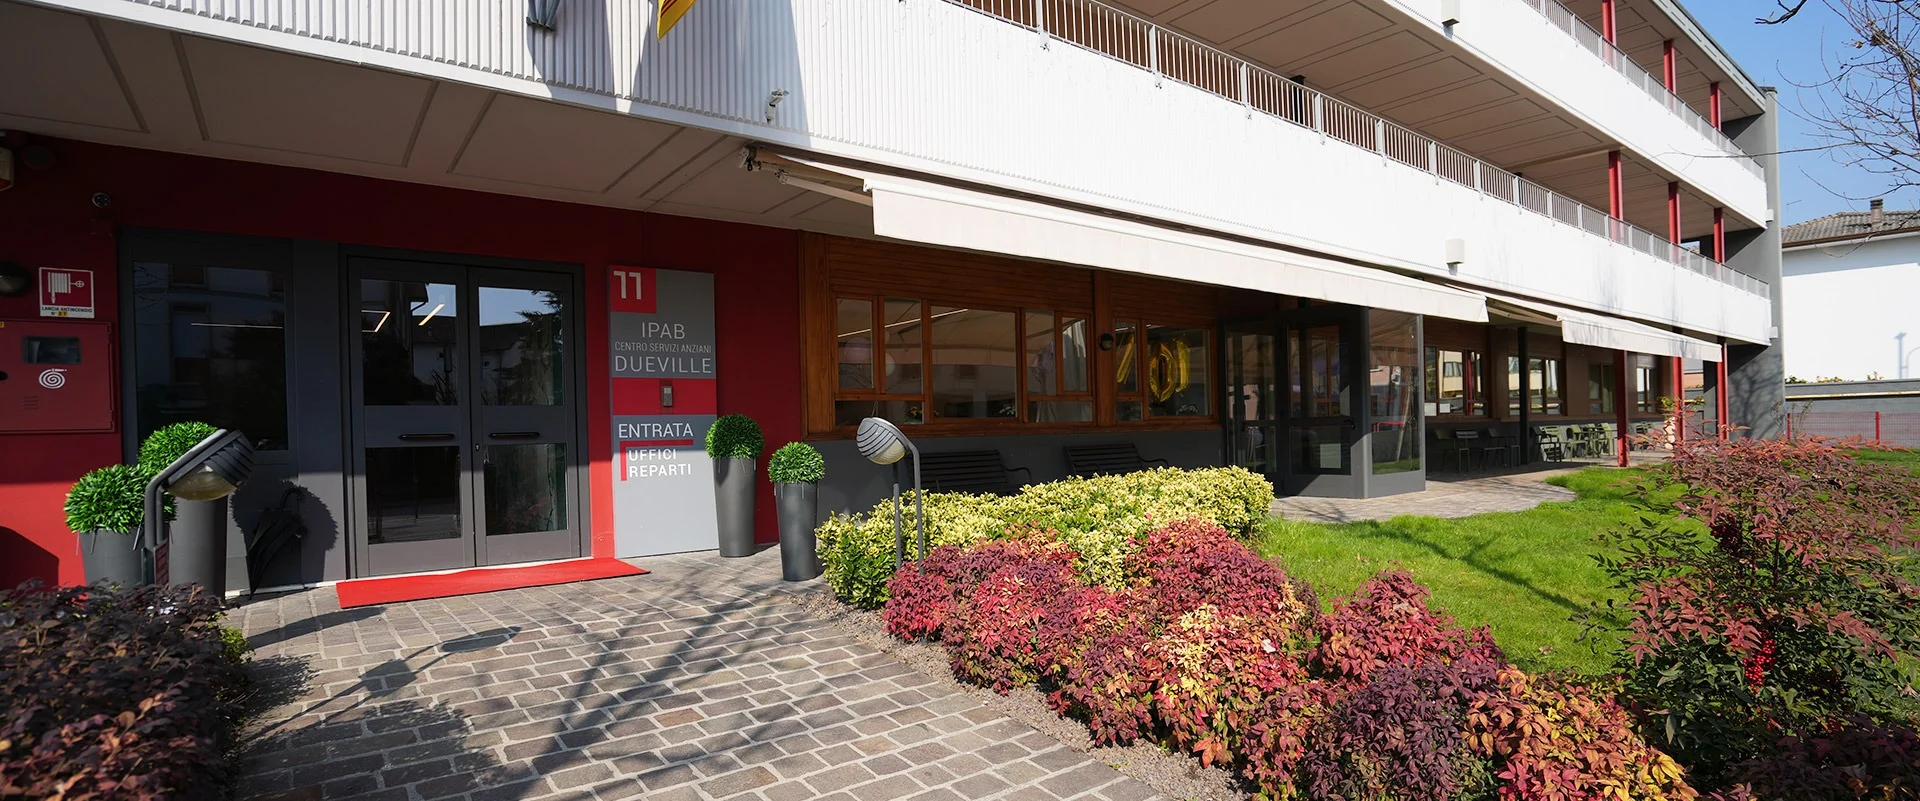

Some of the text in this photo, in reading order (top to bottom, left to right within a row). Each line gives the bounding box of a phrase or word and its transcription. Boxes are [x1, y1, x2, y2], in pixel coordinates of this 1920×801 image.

[641, 322, 686, 340] IPAB
[614, 341, 712, 354] CENTRO SERVIZI ANZIANI
[615, 355, 712, 374] DUEVILLE
[618, 423, 694, 439] ENTRATA
[628, 448, 677, 462] UFFICI
[628, 463, 691, 478] REPARTI
